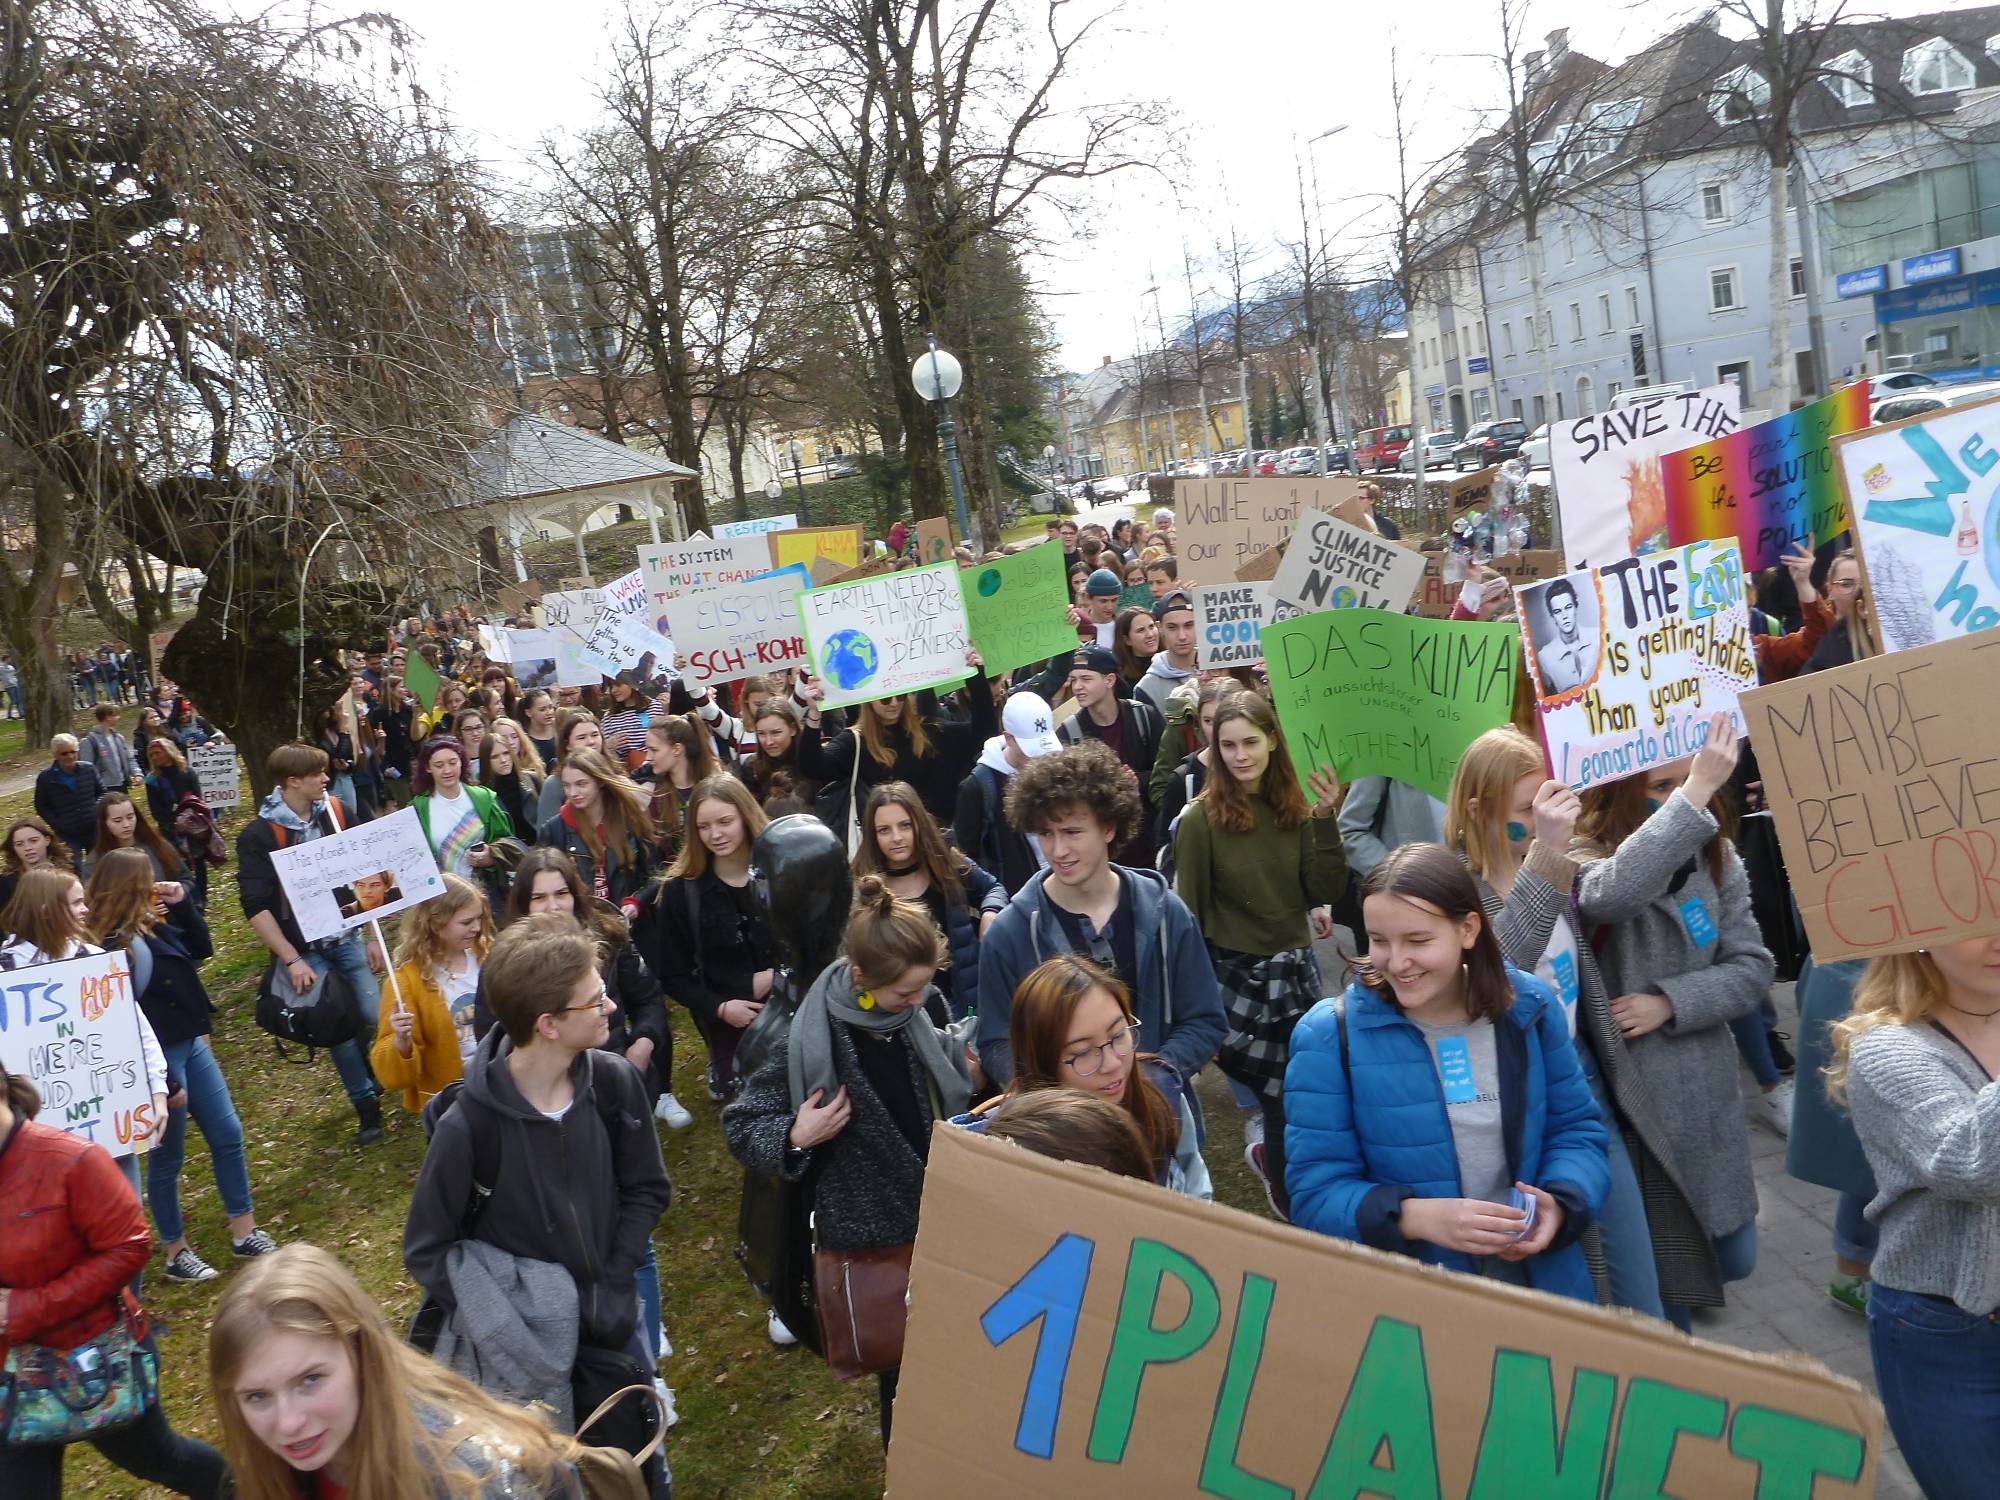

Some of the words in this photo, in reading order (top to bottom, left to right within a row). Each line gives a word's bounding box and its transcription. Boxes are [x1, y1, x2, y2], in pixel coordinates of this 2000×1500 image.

[1572, 400, 1669, 464] SAVE
[1675, 391, 1740, 439] THE
[1688, 455, 1724, 481] Be
[1710, 484, 1737, 511] the
[1750, 446, 1832, 498] SOLUTIO
[1183, 482, 1249, 525] Wall-E
[1769, 487, 1807, 514] not
[724, 519, 784, 538] RESPECT
[816, 532, 852, 556] KLIMA
[1311, 520, 1398, 571] CLIMATE
[649, 553, 675, 572] THE
[679, 547, 734, 567] SYSTEM
[1308, 546, 1385, 590] JUSTICE
[1515, 556, 1538, 576] die
[610, 572, 643, 600] WAKE
[669, 572, 714, 587] MUST
[812, 583, 874, 617] EARTH
[884, 571, 947, 601] NEEDS
[1203, 588, 1254, 608] MAKE
[1600, 557, 1680, 630] THE
[695, 587, 797, 631] EISPOLE
[866, 589, 961, 626] THINKERS
[1206, 603, 1262, 624] EARTH
[728, 629, 767, 646] STATT
[904, 616, 939, 641] NOT
[1605, 633, 1629, 676] is
[1637, 616, 1706, 681] getting
[1707, 615, 1755, 680] hotter
[622, 644, 636, 658] us
[1209, 644, 1263, 663] AGAIN
[1282, 622, 1393, 681] DAS
[1411, 628, 1512, 707] KLIMA
[1292, 687, 1312, 709] ist
[1436, 706, 1462, 722] als
[1583, 688, 1637, 736] than
[1650, 676, 1702, 726] young
[1766, 662, 1961, 800] MAYBE
[1302, 723, 1457, 781] MATHE-MA
[1562, 729, 1659, 791] Leonardo
[204, 789, 237, 804] ERIOD
[1796, 757, 2000, 874] BELIEVE
[80, 971, 131, 1019] HOT
[56, 1020, 74, 1039] IN
[28, 1033, 104, 1081] HERE
[41, 1080, 73, 1111] ND
[90, 1060, 137, 1094] IT'S
[65, 1095, 104, 1123] NOT
[114, 1103, 154, 1145] US
